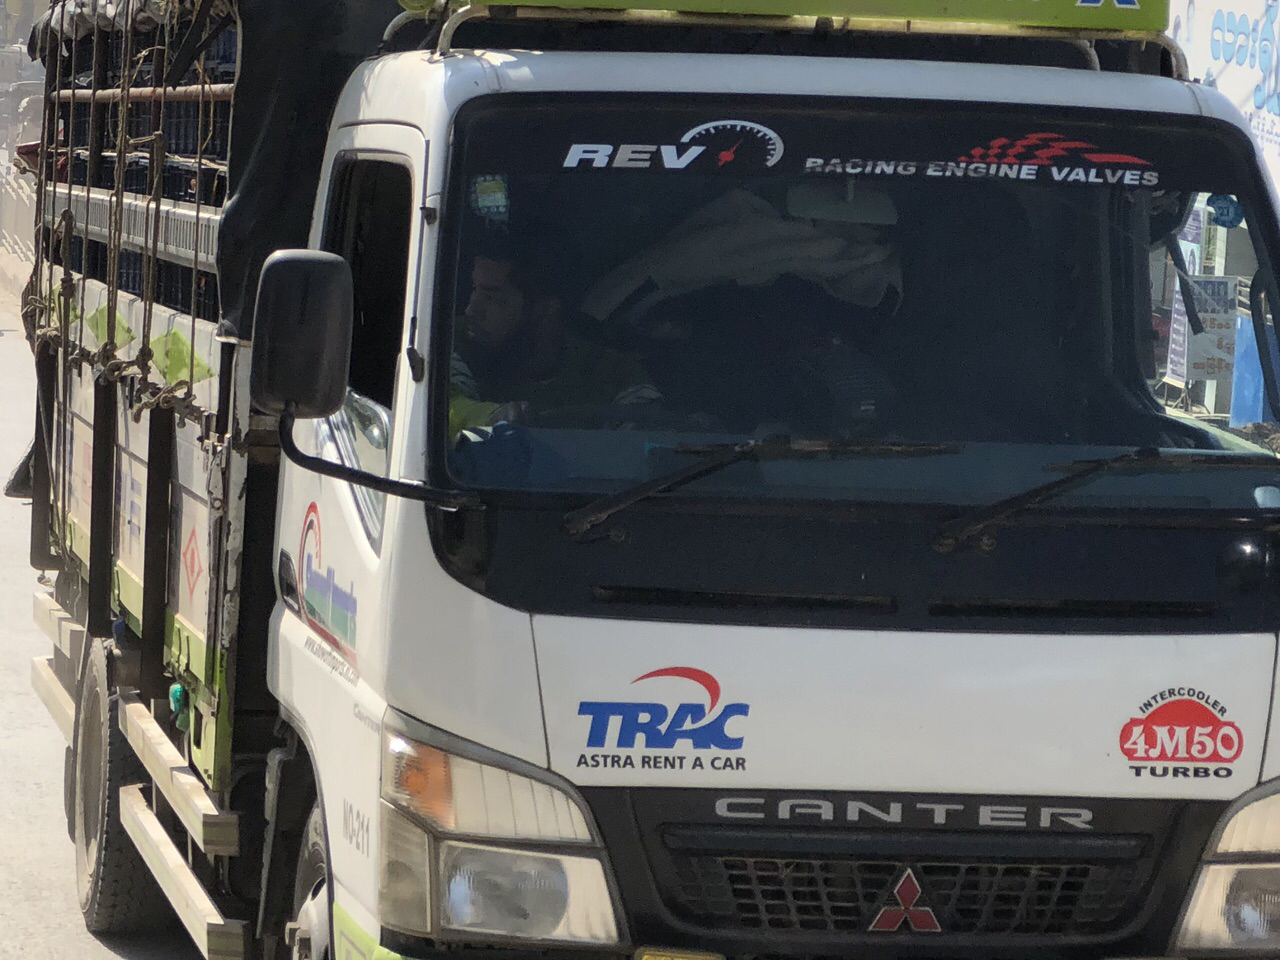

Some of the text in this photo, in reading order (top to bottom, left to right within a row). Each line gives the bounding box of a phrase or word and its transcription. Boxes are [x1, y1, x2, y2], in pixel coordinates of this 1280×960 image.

[563, 144, 707, 169] REV
[805, 157, 1160, 186] RACING ENGINE VALVES
[1139, 687, 1227, 717] INTERCOOLER
[578, 701, 750, 750] TRAC
[1123, 725, 1239, 759] 4M50
[576, 754, 746, 771] ASTRA RENT A CAR
[1129, 766, 1233, 778] TURBO
[343, 798, 369, 858] NO-211
[715, 797, 1093, 830] CANTER
